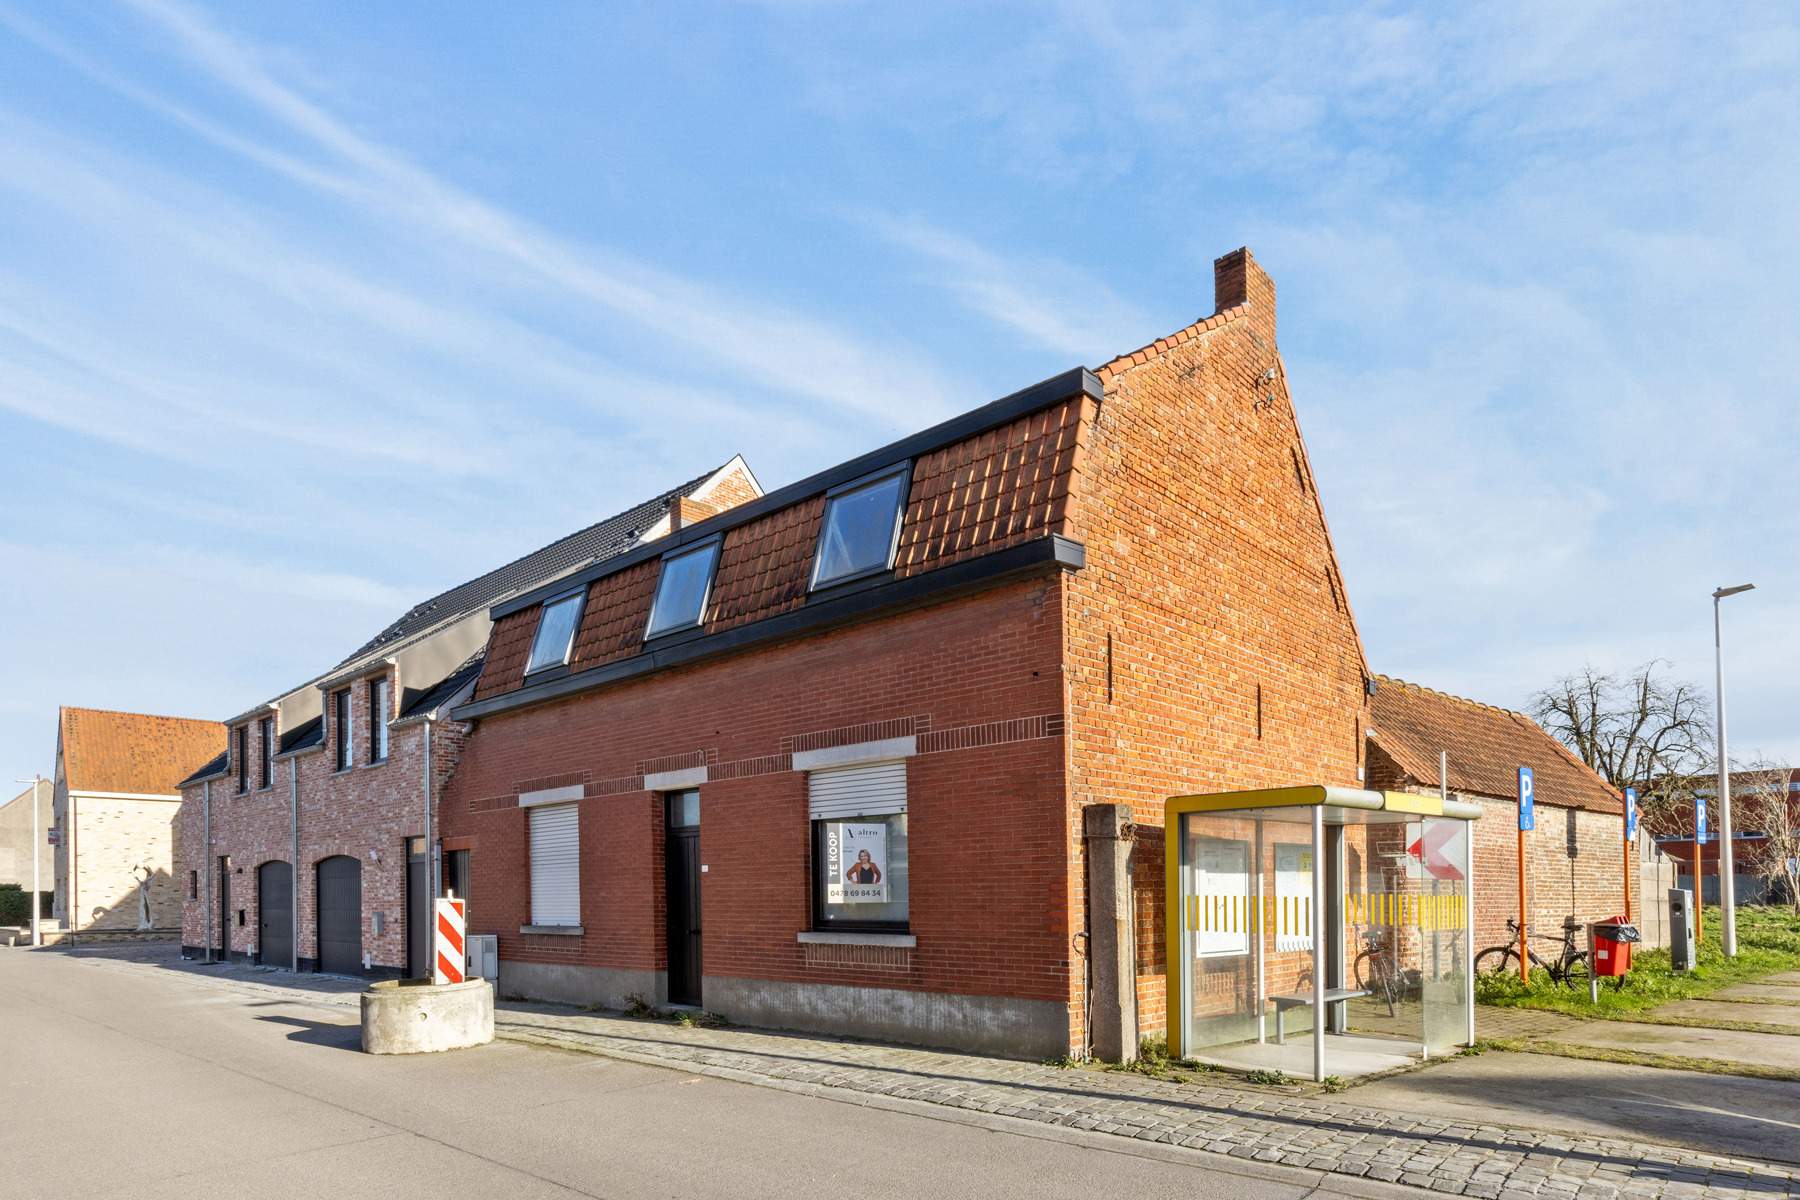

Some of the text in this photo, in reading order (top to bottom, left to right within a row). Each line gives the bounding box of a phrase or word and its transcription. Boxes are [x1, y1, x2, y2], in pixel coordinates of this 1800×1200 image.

[1521, 775, 1532, 807] P
[1628, 794, 1635, 821] P
[1698, 804, 1705, 827] P
[829, 832, 838, 876] TE KOOP
